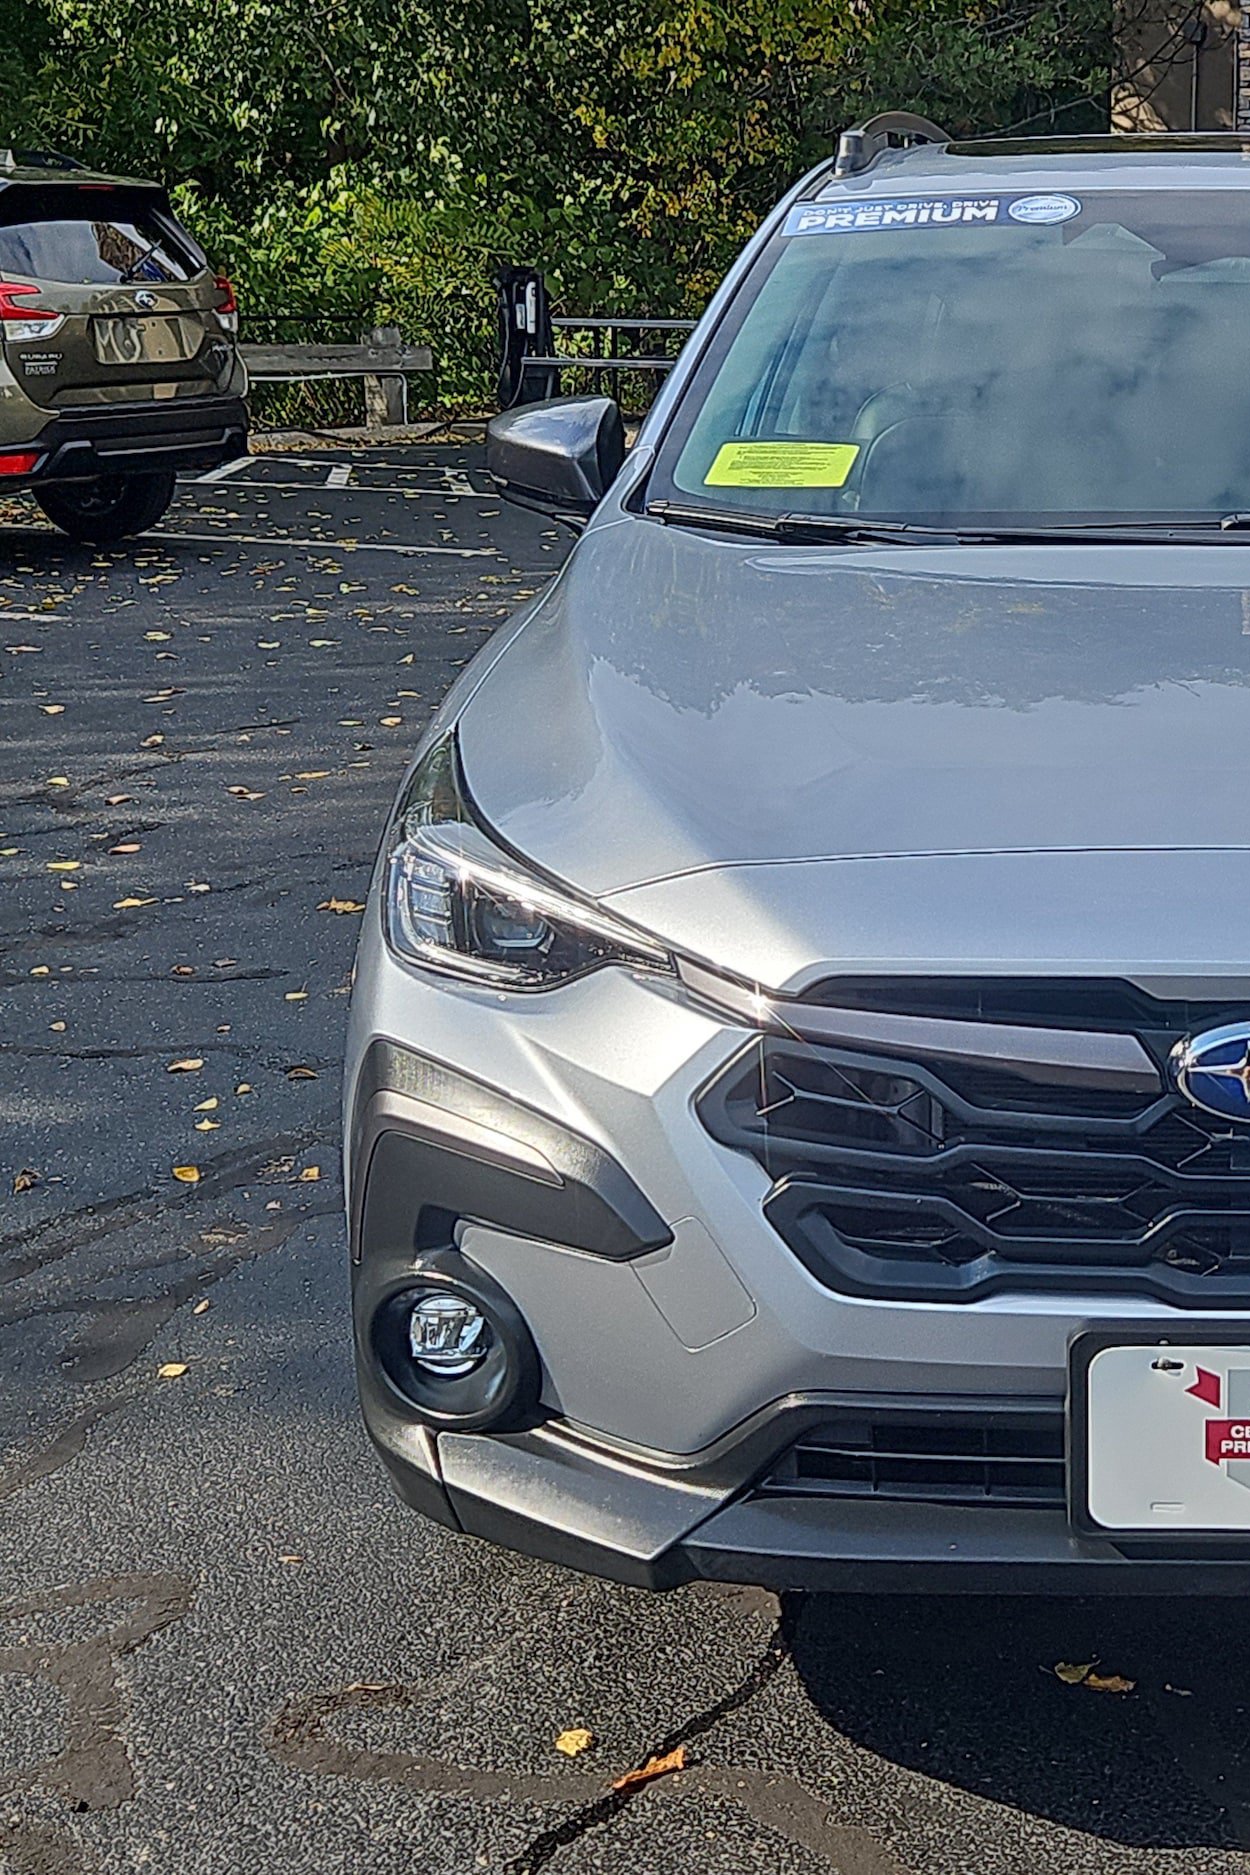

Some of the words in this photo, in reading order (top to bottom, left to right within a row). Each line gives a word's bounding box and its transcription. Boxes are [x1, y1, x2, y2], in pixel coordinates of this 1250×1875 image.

[802, 206, 852, 216] DON'T
[855, 204, 894, 213] JUST
[951, 199, 1000, 208] DRIVE
[798, 206, 999, 230] PREMIUM
